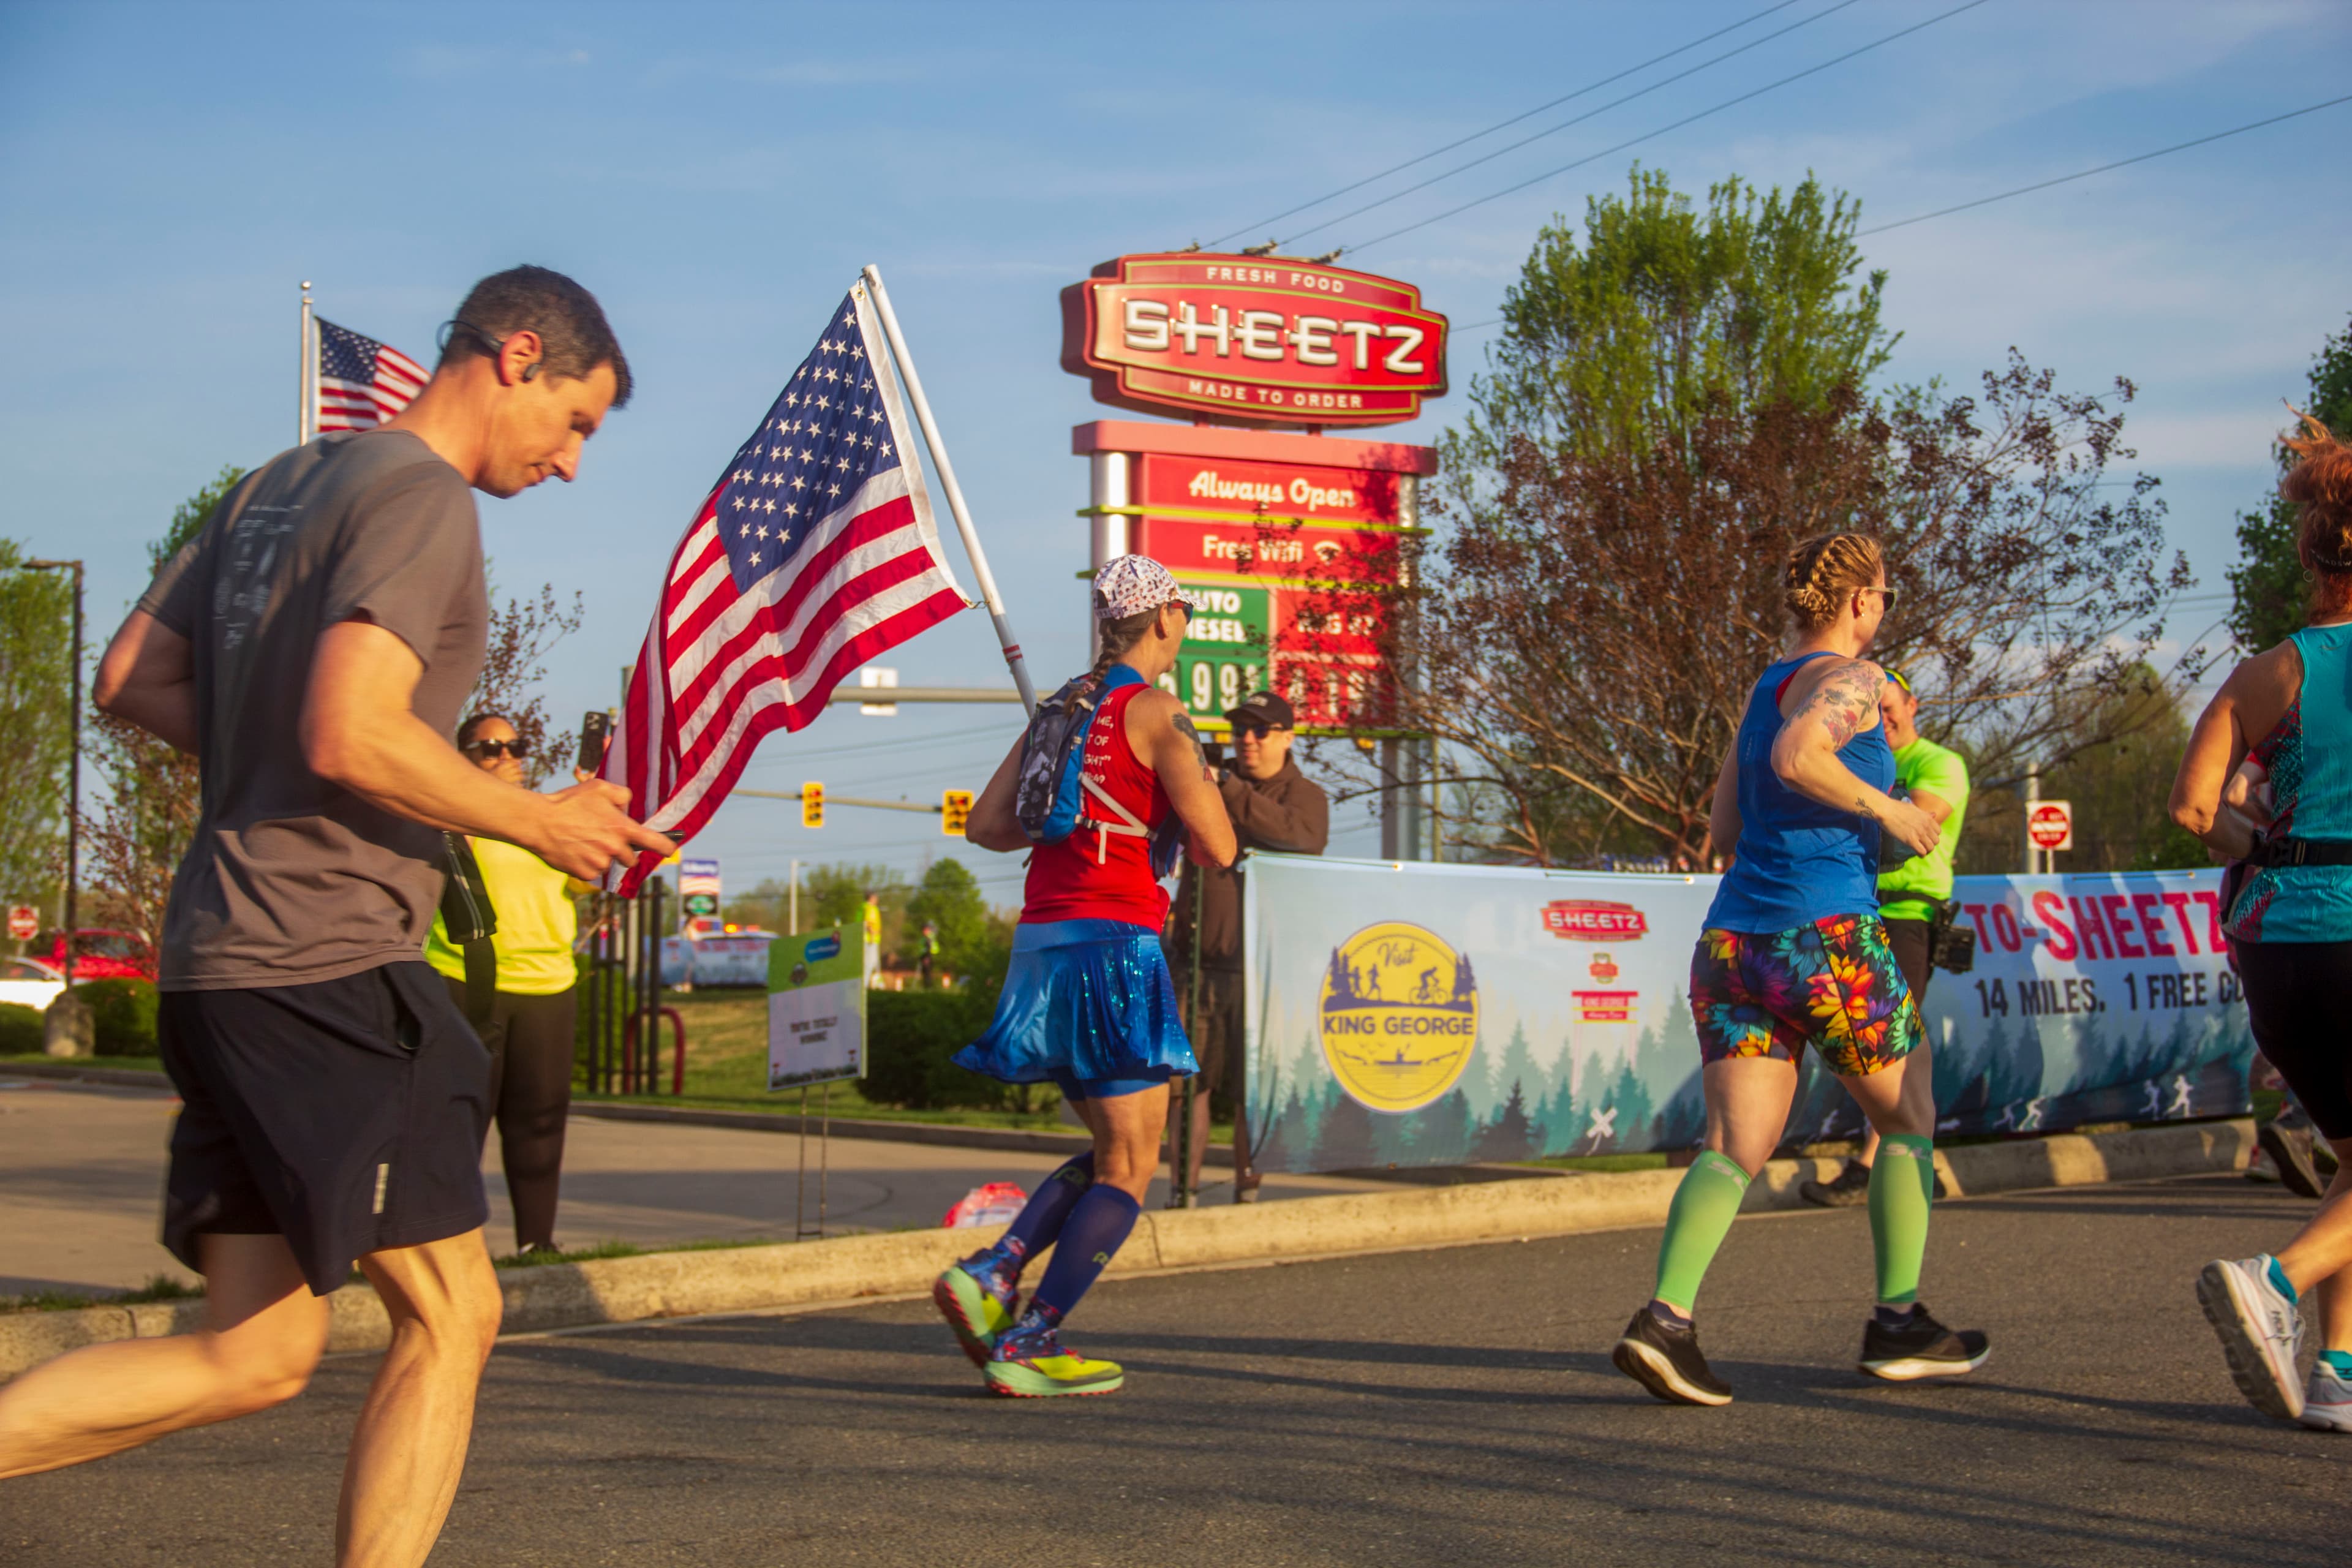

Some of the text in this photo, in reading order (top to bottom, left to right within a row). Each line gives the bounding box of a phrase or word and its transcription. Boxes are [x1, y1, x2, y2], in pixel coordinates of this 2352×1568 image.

[1207, 266, 1344, 293] FRESH FOOD
[1123, 298, 1424, 375] SHEETZ
[1188, 380, 1362, 409] MADE TO ORDER
[1189, 470, 1356, 512] Always Open
[1202, 534, 1253, 560] Free
[1186, 617, 1247, 643] IESEL
[1094, 736, 1109, 747] OF
[1548, 911, 1641, 930] SHEETZ
[1377, 942, 1419, 968] Visit
[1974, 977, 2008, 1018] 14
[2123, 972, 2138, 1011] 1
[2146, 971, 2207, 1009] FREE
[1323, 1016, 1474, 1035] KING GEORGE
